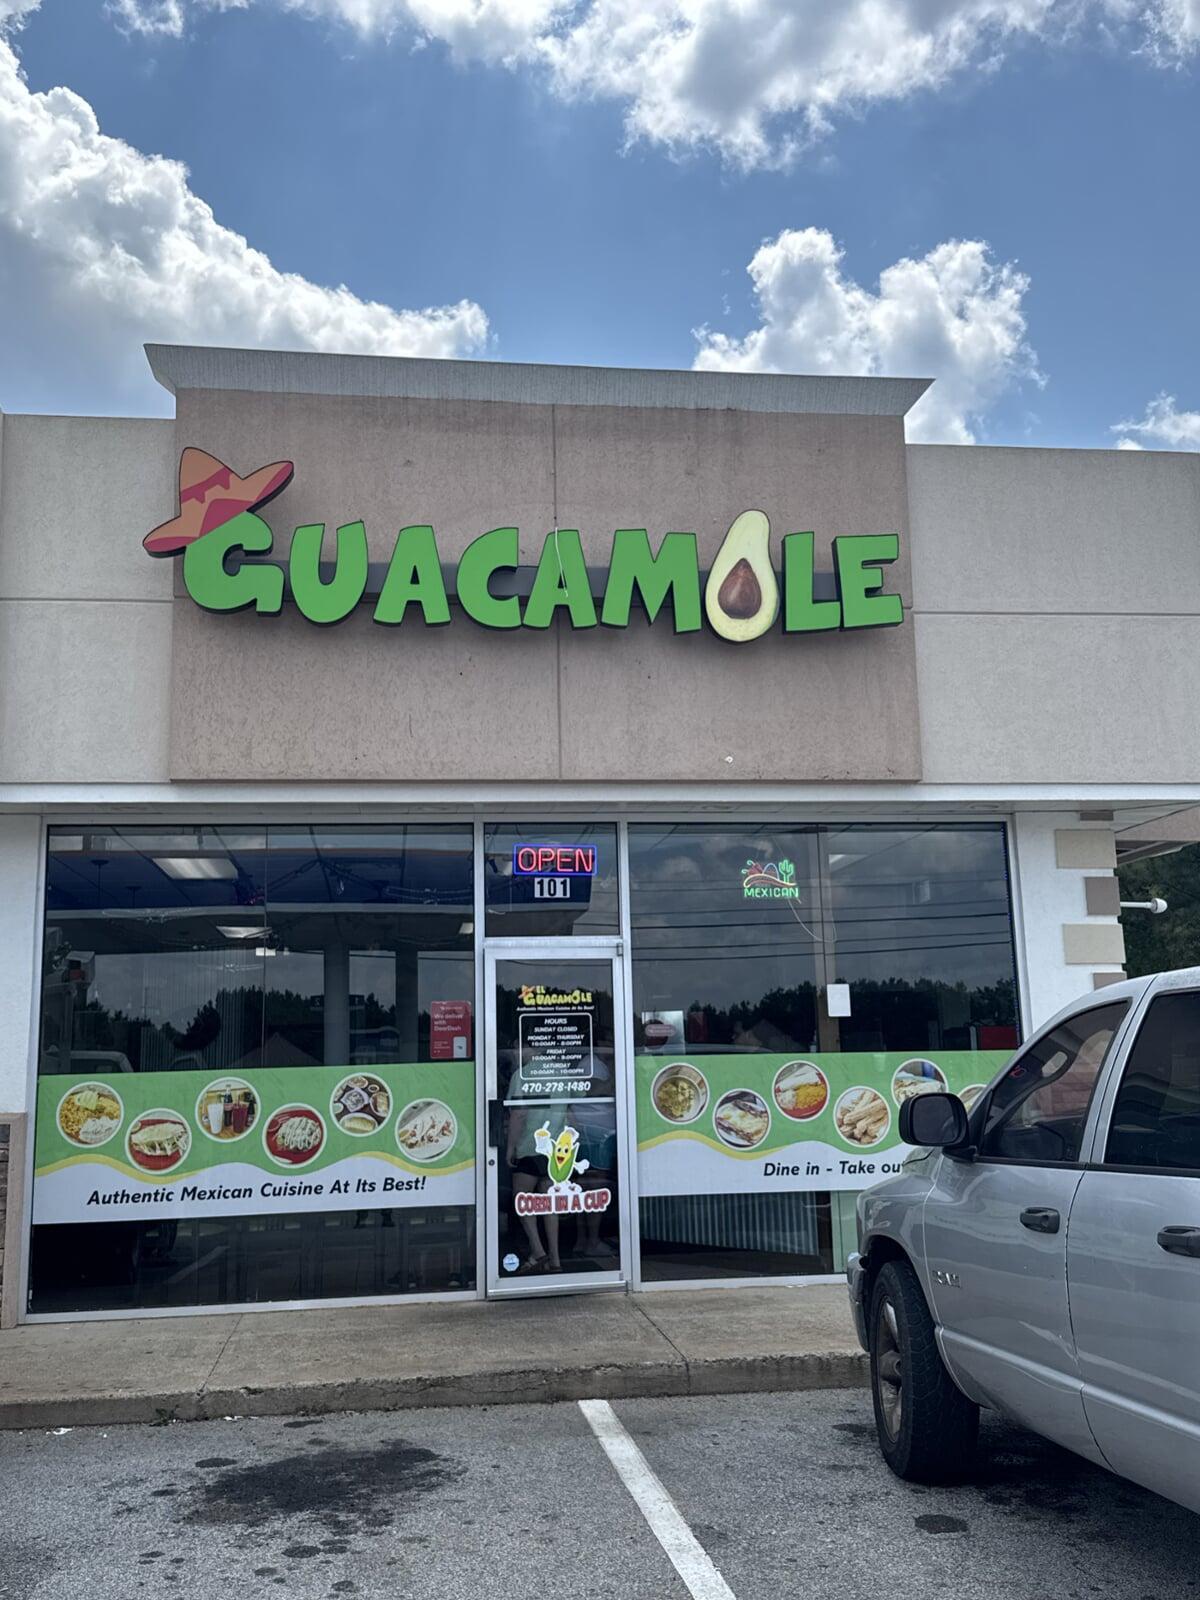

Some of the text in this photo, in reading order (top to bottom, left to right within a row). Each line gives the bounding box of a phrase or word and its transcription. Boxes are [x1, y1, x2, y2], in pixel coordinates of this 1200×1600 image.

[182, 509, 905, 643] GUACAMOLE
[518, 847, 593, 872] OPEN
[536, 878, 568, 897] 101
[744, 887, 799, 898] MEXICAN
[523, 989, 593, 1006] GUACAMOLE
[536, 985, 546, 994] EL
[521, 1081, 591, 1093] 470-278-1480
[763, 1162, 800, 1177] Dine
[806, 1161, 820, 1176] in
[839, 1160, 875, 1175] Take
[881, 1160, 904, 1174] ou
[87, 1176, 427, 1206] Authentic Mexican Cuisine At Its Best!
[517, 1190, 610, 1214] CORN IN A CUP
